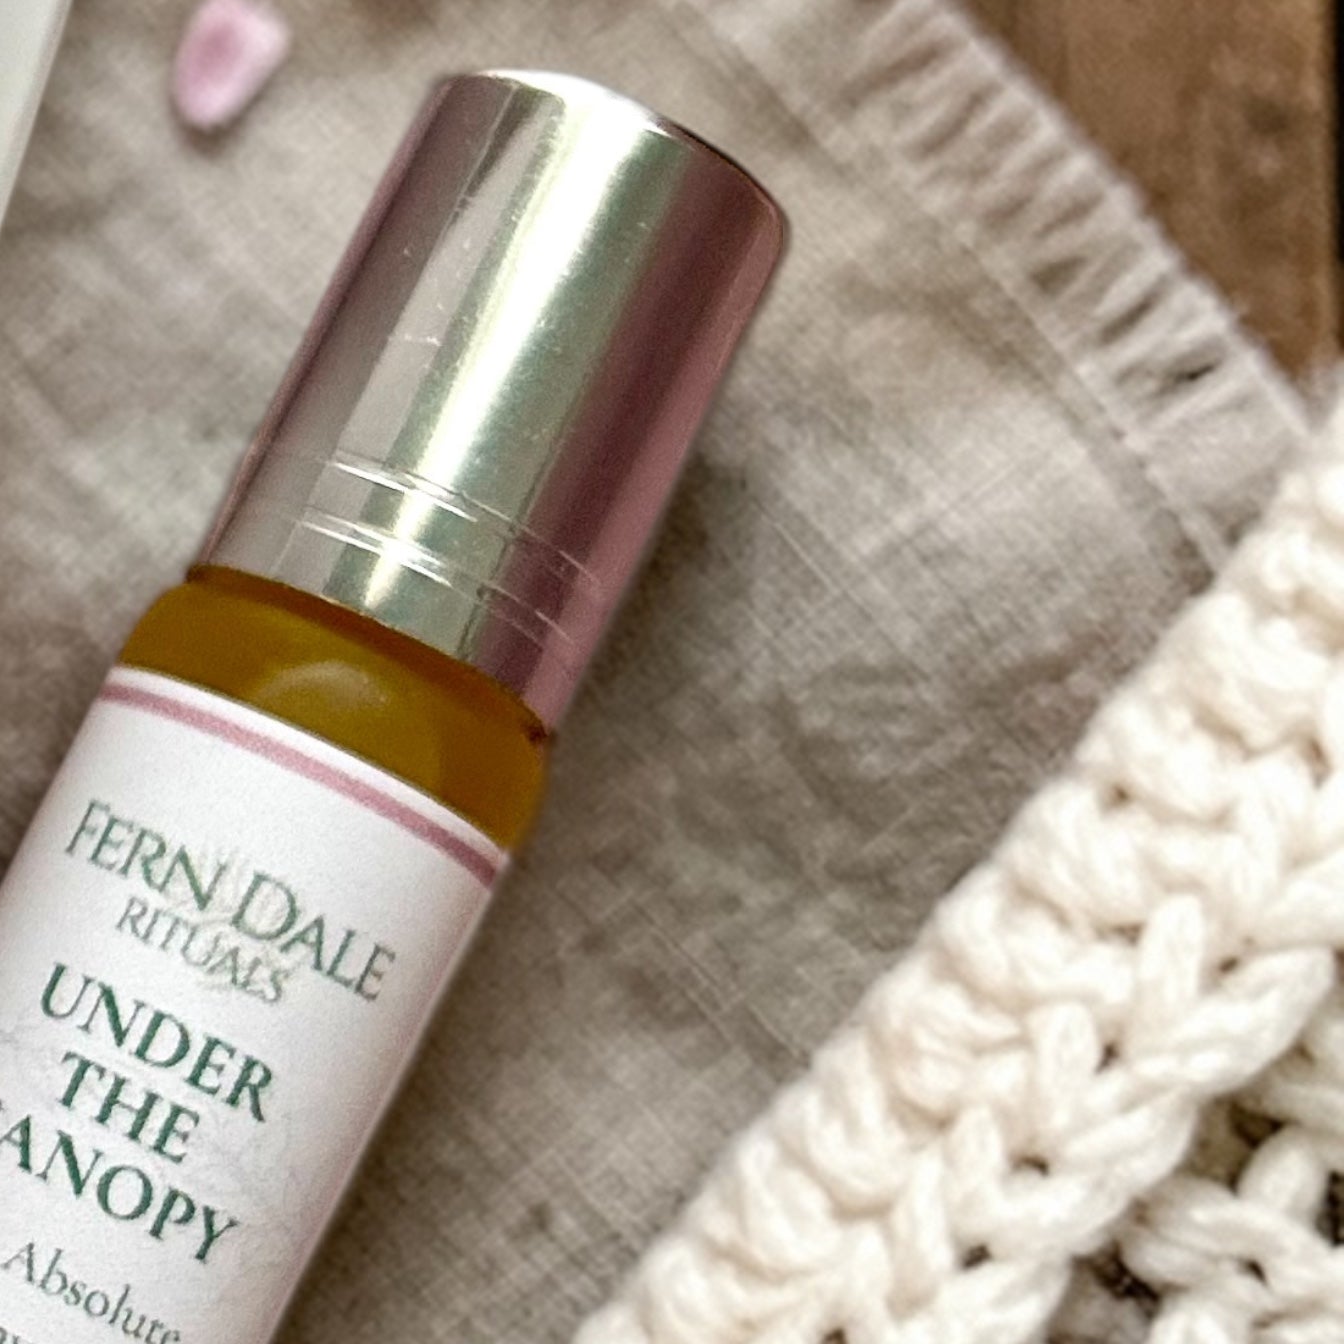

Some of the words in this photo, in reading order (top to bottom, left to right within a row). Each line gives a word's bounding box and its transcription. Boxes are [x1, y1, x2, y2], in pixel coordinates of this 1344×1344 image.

[65, 801, 225, 912] FERN
[232, 868, 397, 1002] DALE
[116, 898, 292, 1003] RITUALS
[41, 963, 275, 1121] UNDER
[59, 1051, 200, 1163] THE
